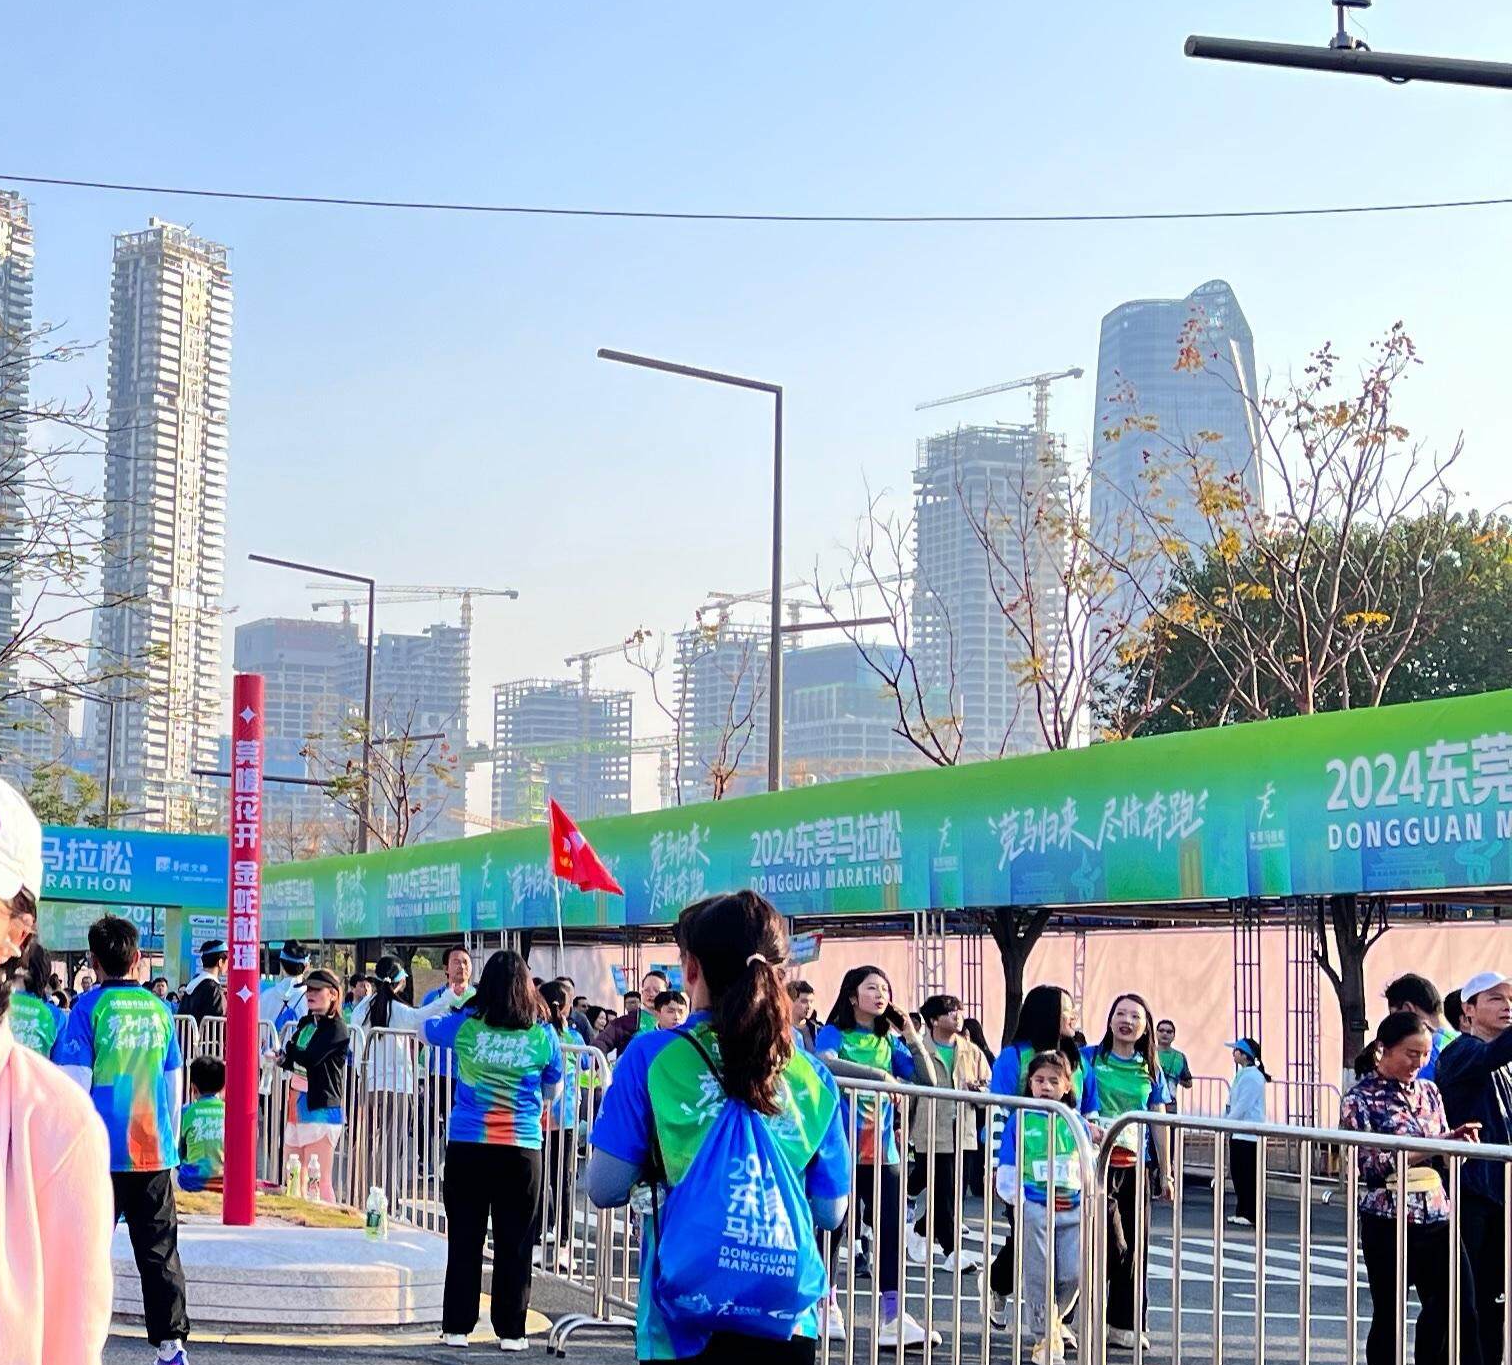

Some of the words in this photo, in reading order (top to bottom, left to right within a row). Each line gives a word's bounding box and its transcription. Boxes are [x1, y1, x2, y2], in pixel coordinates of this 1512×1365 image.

[750, 810, 903, 868] 2024东莞马拉松
[1328, 811, 1484, 851] DONGGUAN
[42, 836, 134, 877] 马拉松
[45, 873, 132, 893] RATHON
[825, 864, 903, 889] MARATHON
[233, 860, 258, 971] 金蛇献瑞
[717, 1257, 796, 1278] MARATHON
[719, 1245, 797, 1266] DONGGUAN
